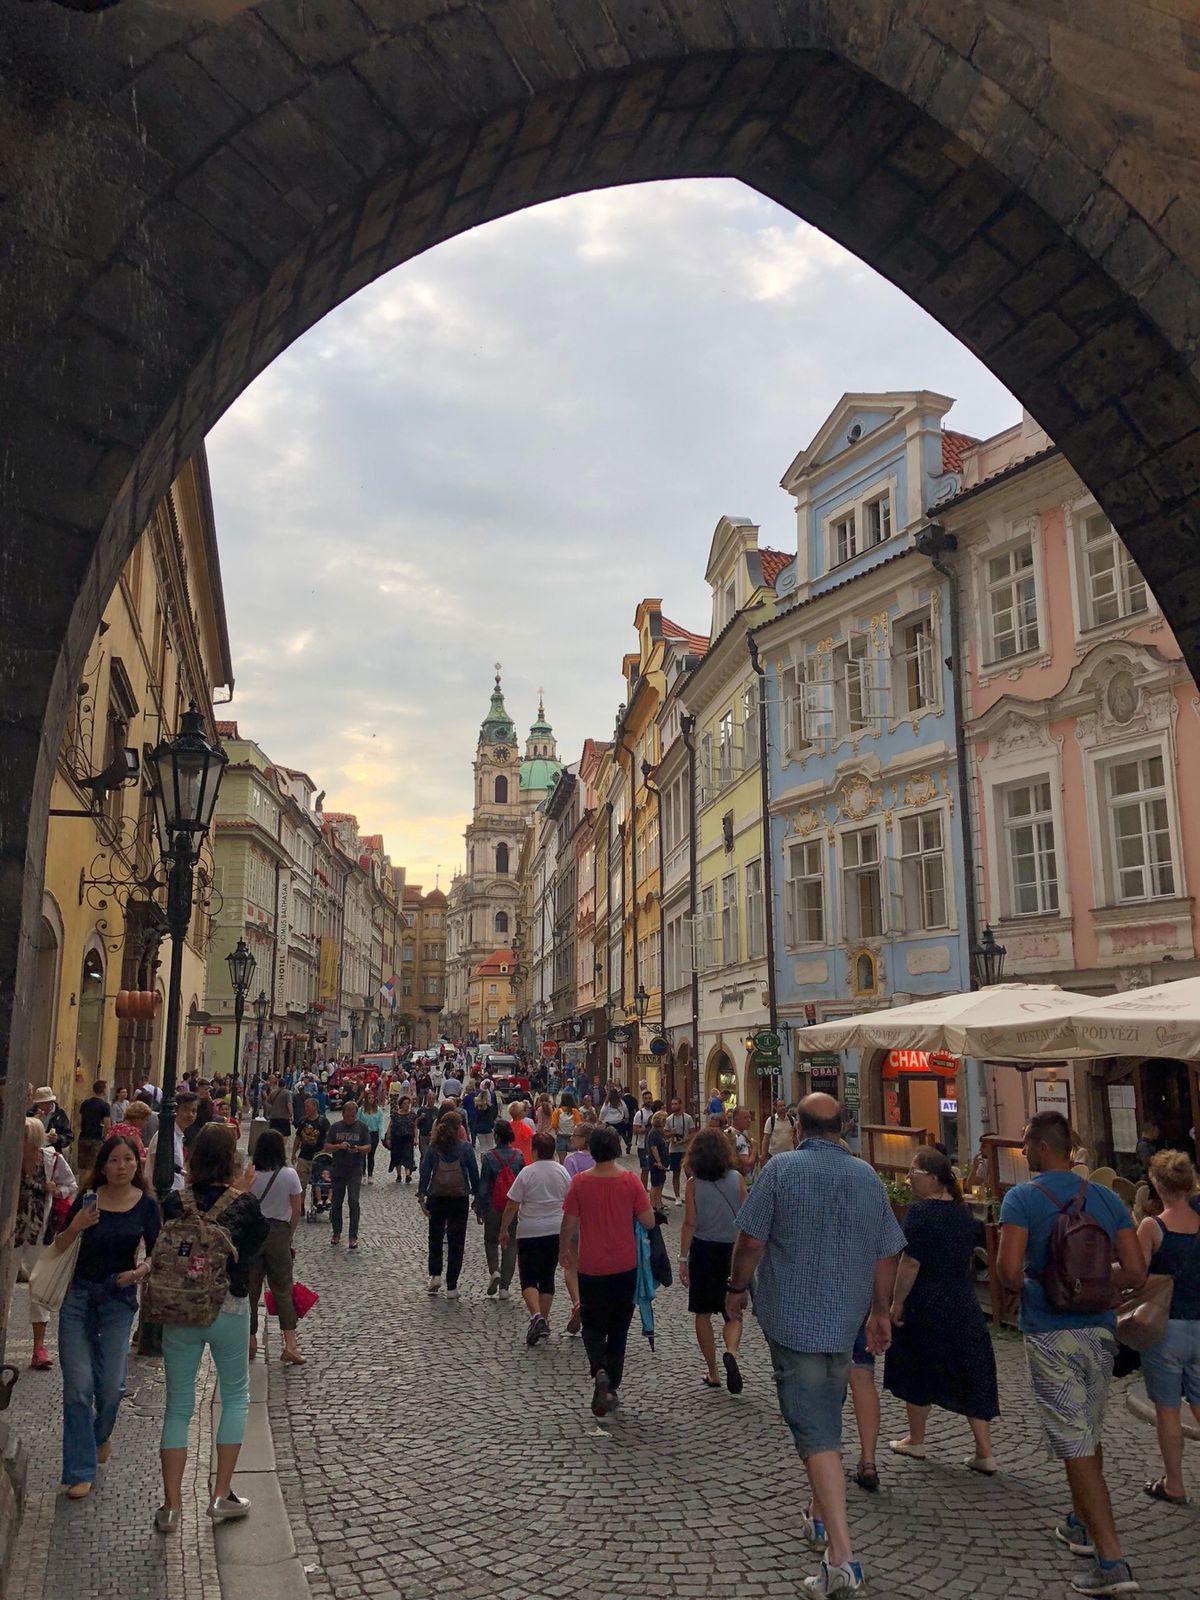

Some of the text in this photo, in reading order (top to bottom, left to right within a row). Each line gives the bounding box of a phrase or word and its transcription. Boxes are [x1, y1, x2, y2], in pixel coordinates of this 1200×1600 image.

[280, 883, 288, 918] BALTHASAR
[278, 954, 286, 980] HOTEL
[1016, 1025, 1080, 1043] RESTAURANT
[1081, 1025, 1108, 1040] POD
[635, 1055, 660, 1064] CHANGE
[763, 1067, 780, 1075] WC
